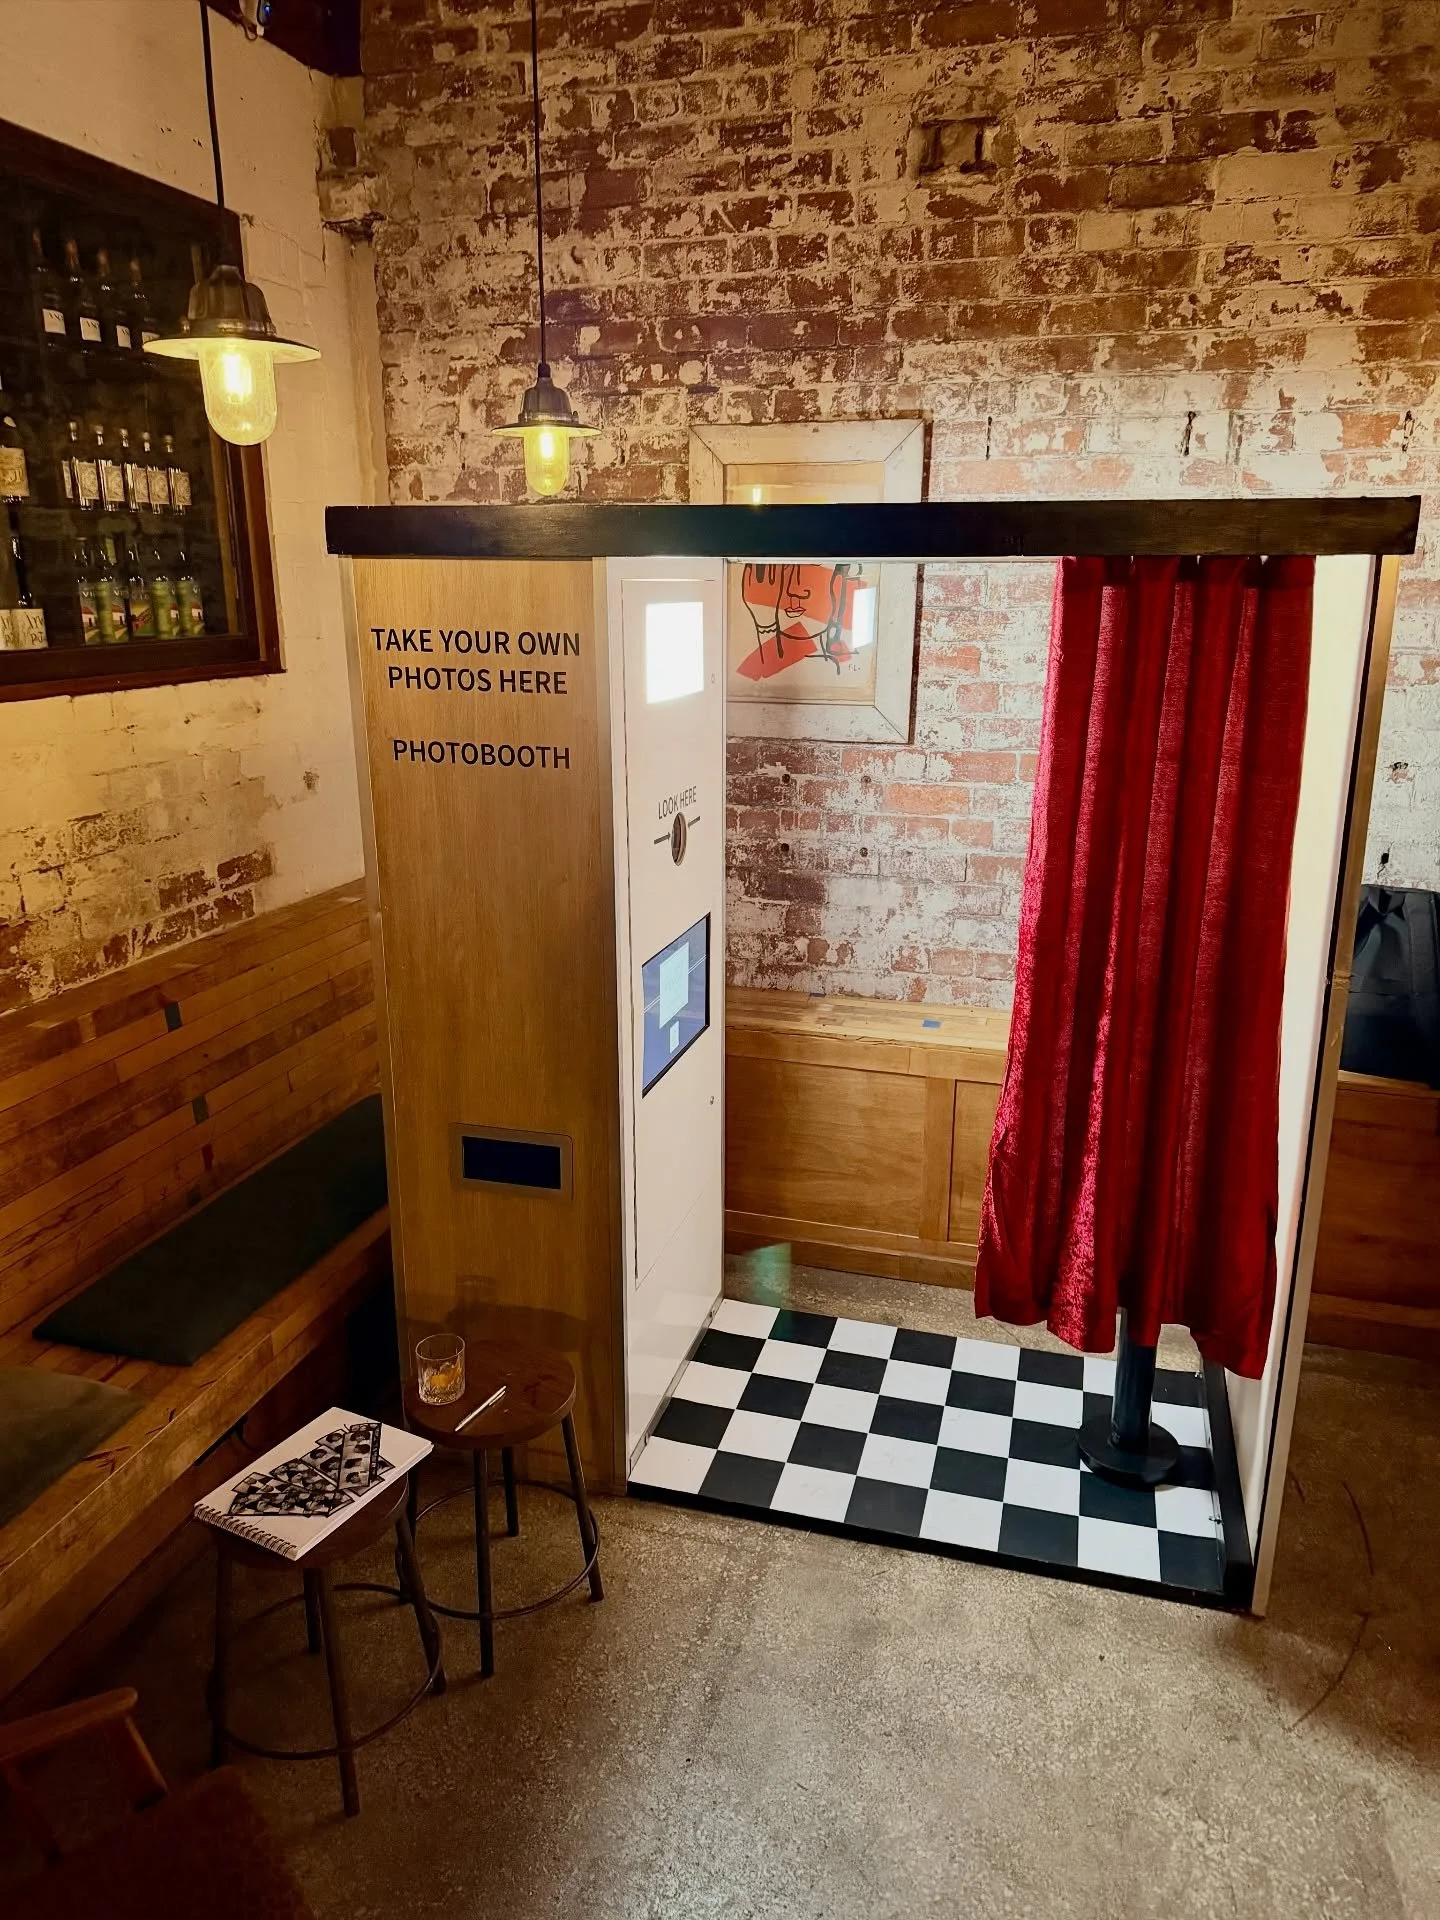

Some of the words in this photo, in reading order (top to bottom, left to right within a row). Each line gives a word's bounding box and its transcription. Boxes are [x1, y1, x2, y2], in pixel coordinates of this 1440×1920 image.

[371, 628, 433, 652] TAKE
[438, 629, 511, 655] YOUR
[517, 631, 580, 656] OWN
[388, 666, 492, 692] PHOTOS
[499, 669, 568, 694] HERE
[393, 739, 570, 769] PHOTOBOOTH
[658, 793, 679, 820] LOOK
[679, 785, 697, 809] HERE
